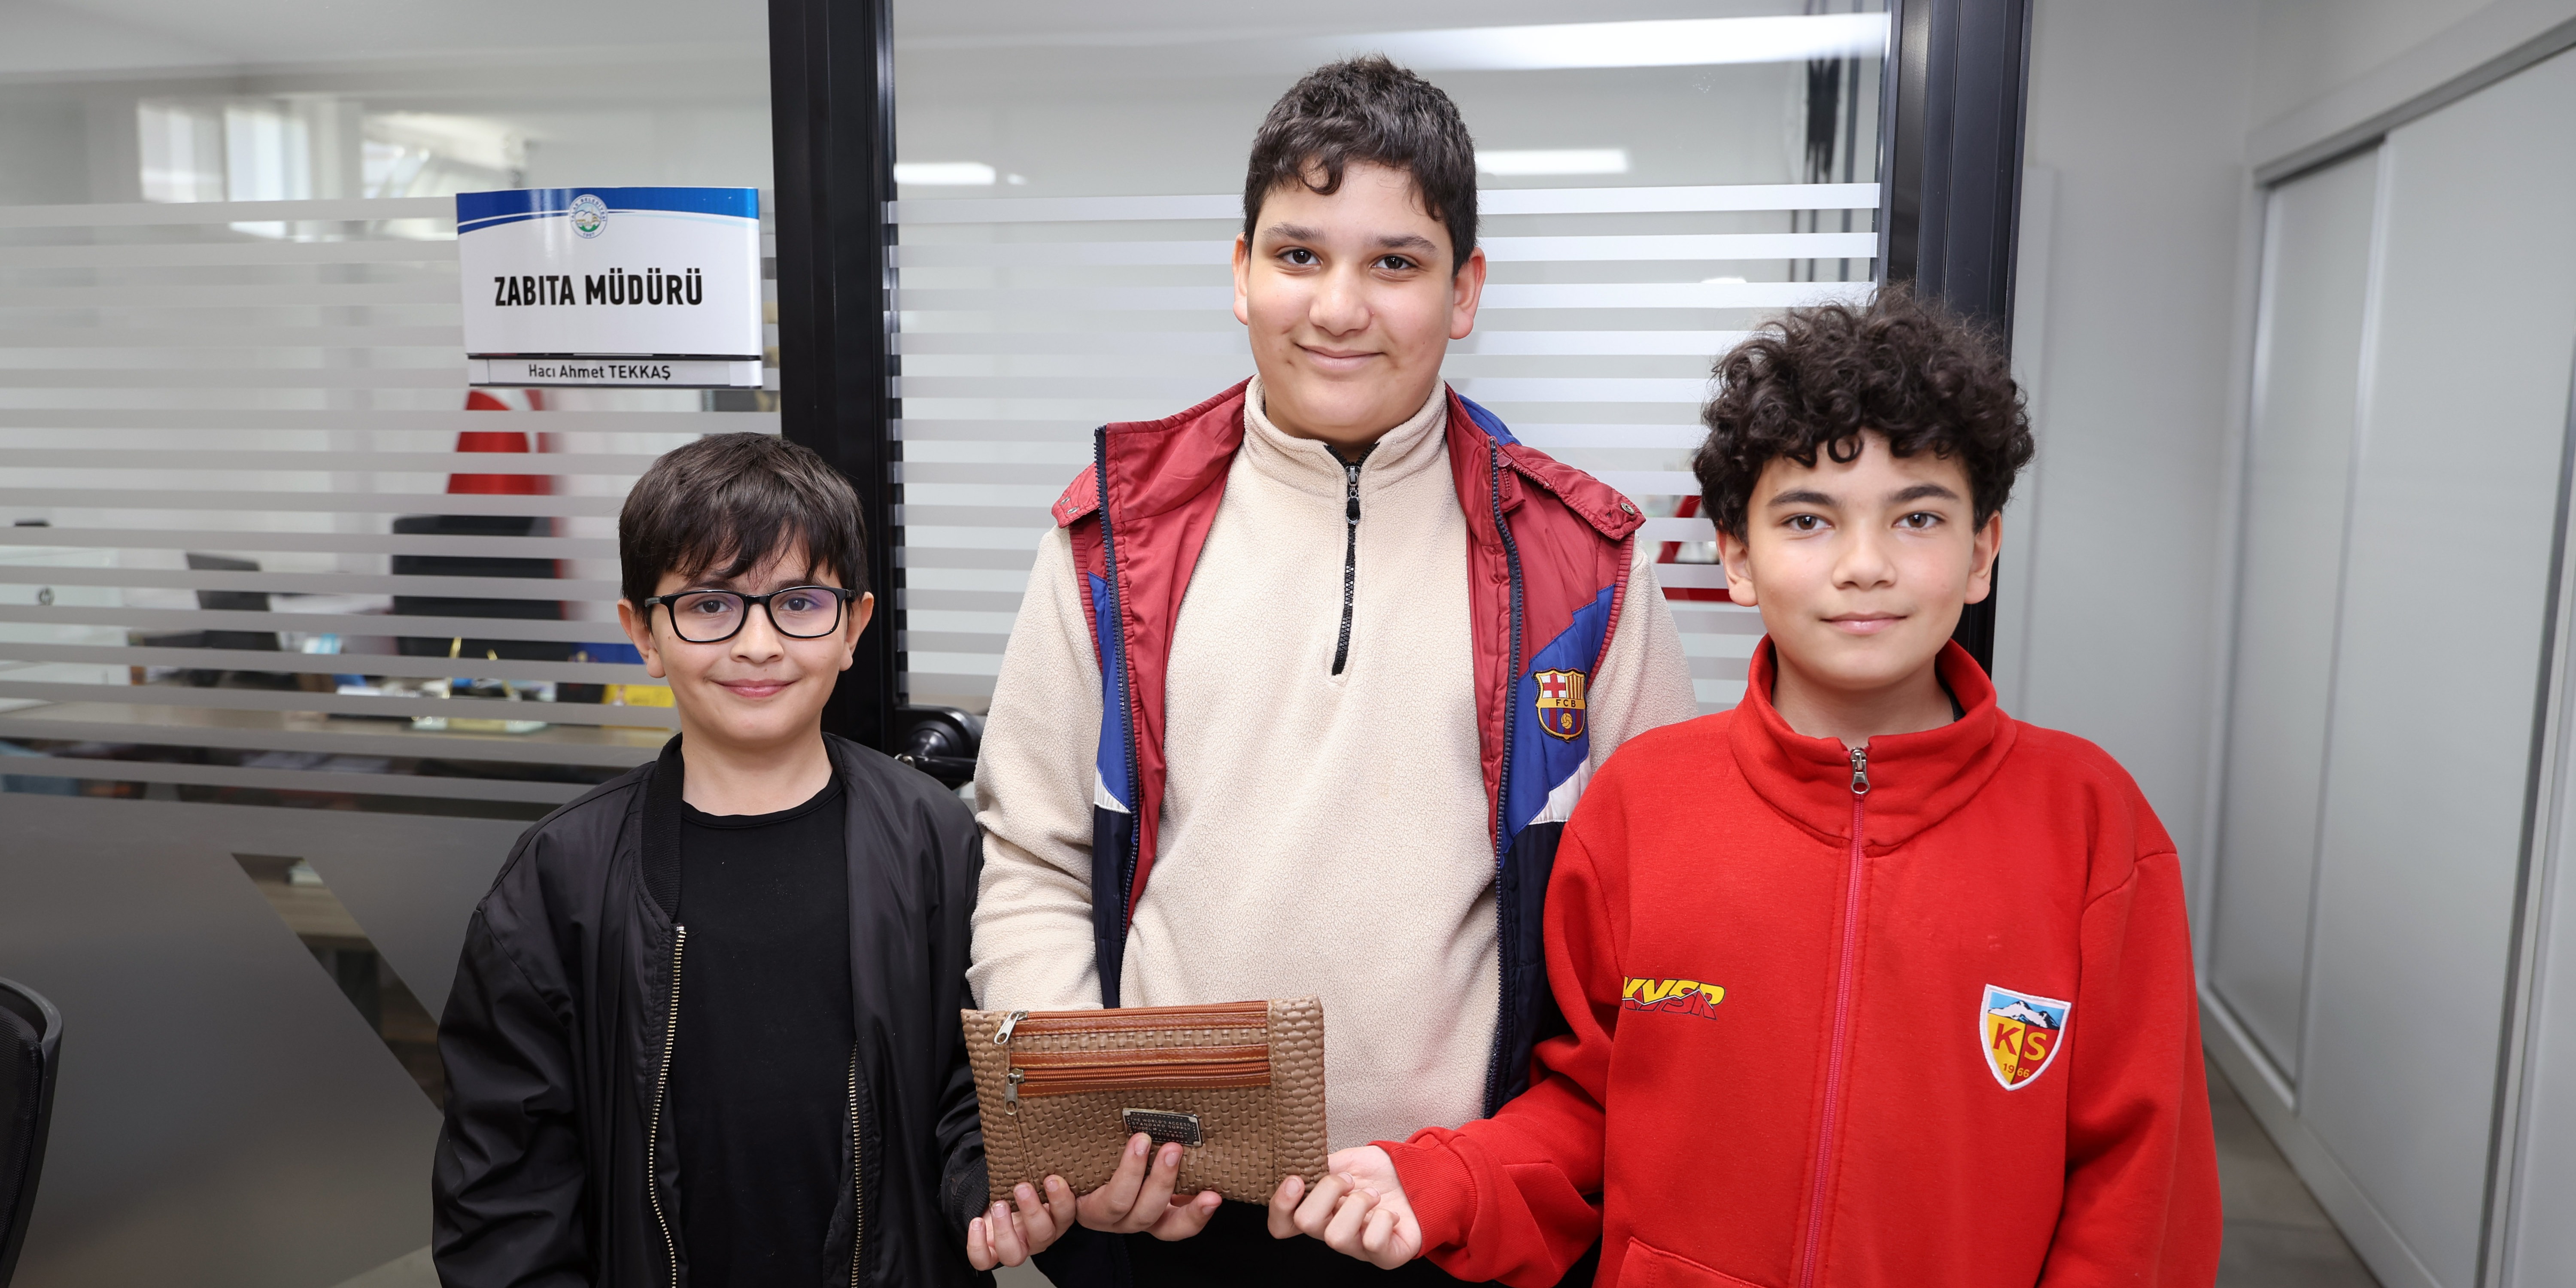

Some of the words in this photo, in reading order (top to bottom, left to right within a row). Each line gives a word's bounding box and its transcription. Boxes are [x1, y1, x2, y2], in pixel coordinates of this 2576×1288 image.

[494, 275, 576, 307] ZABITA
[585, 267, 703, 306] MÜDÜRÜ
[529, 364, 556, 377] Hacı
[559, 365, 605, 378] Ahmet
[608, 365, 671, 380] TEKKAŞ
[1992, 1022, 2047, 1061] KS
[2003, 1063, 2030, 1078] 1966
